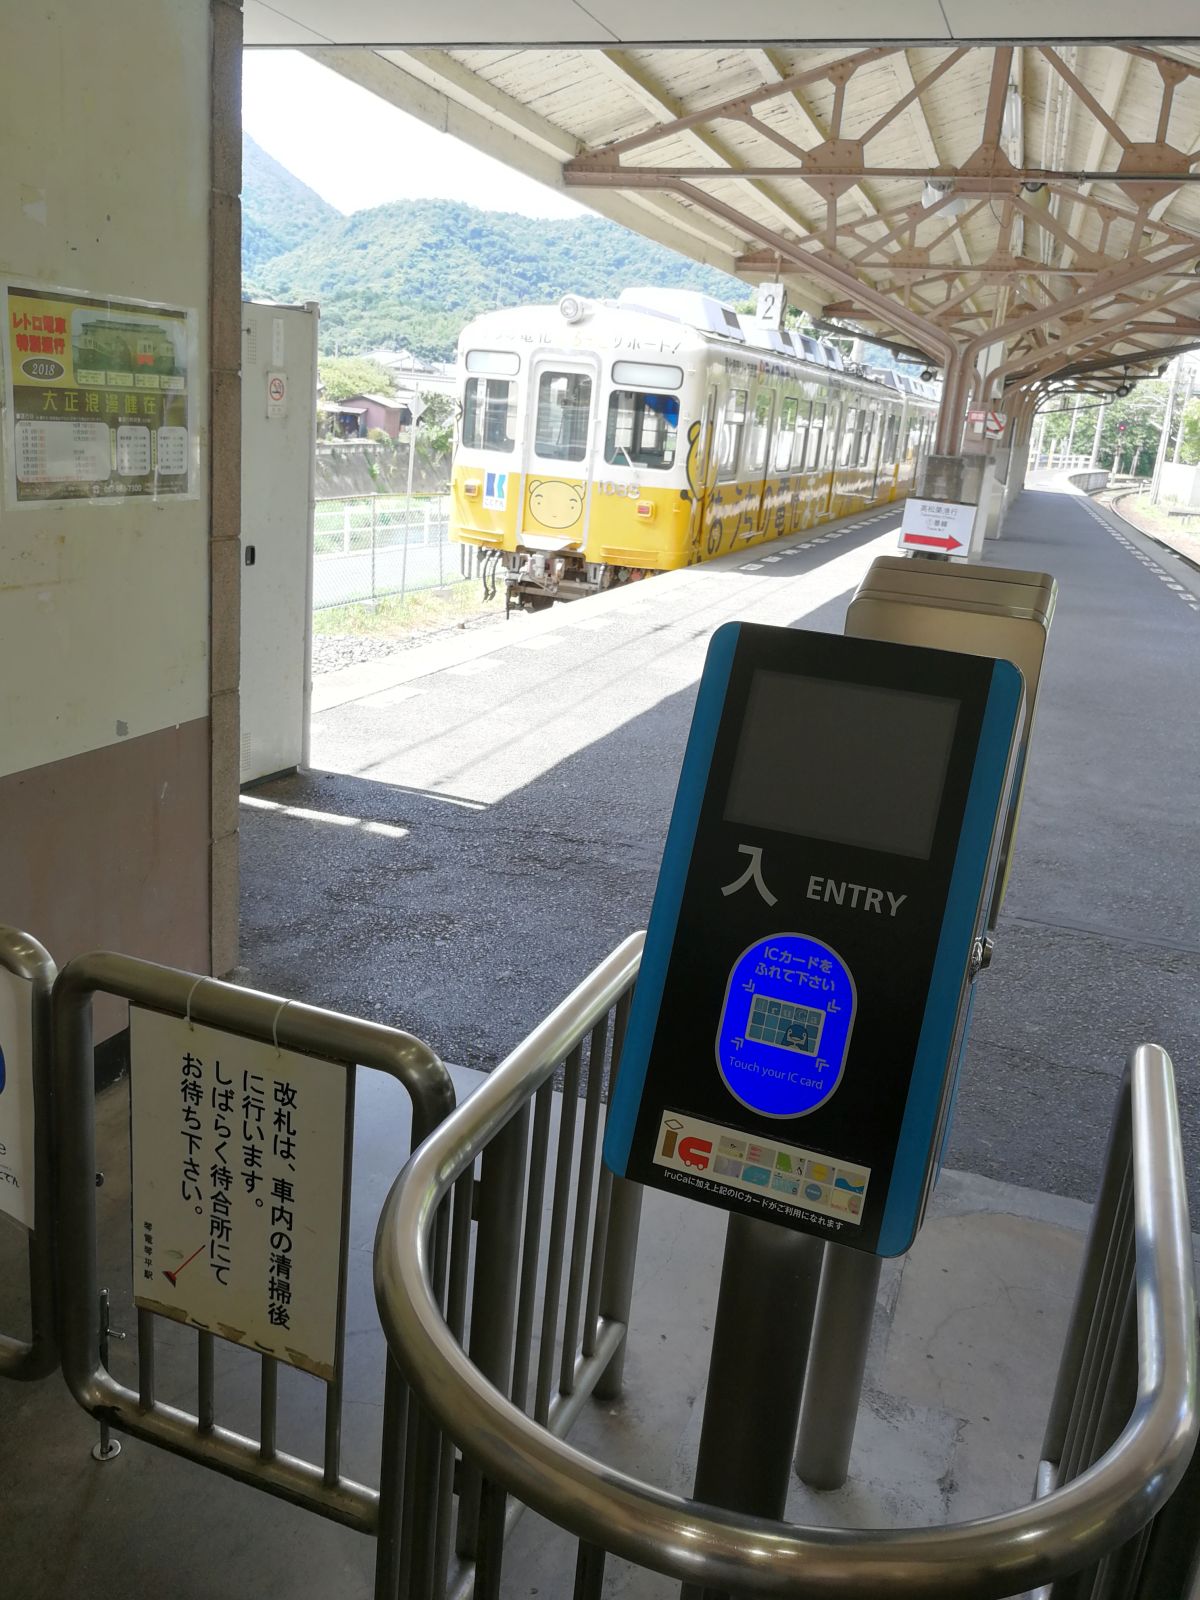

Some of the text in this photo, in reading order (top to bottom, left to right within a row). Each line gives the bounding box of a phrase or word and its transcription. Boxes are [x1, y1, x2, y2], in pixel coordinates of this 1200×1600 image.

[12, 311, 67, 335] レトロ電車
[762, 294, 775, 320] 2
[31, 363, 56, 376] 2018
[42, 389, 157, 415] 大正浪漫健在
[720, 844, 778, 907] 入
[806, 875, 908, 917] ENTRY
[755, 962, 835, 992] ふれて下さい
[764, 946, 833, 974] ICカードを
[729, 1056, 824, 1090] Touch your IC card
[180, 1052, 204, 1215] お待ち下さい。
[240, 1070, 266, 1208] に行います。
[209, 1060, 235, 1286] しばらく待合所にて
[267, 1081, 298, 1330] 改札は、車内の清掃後
